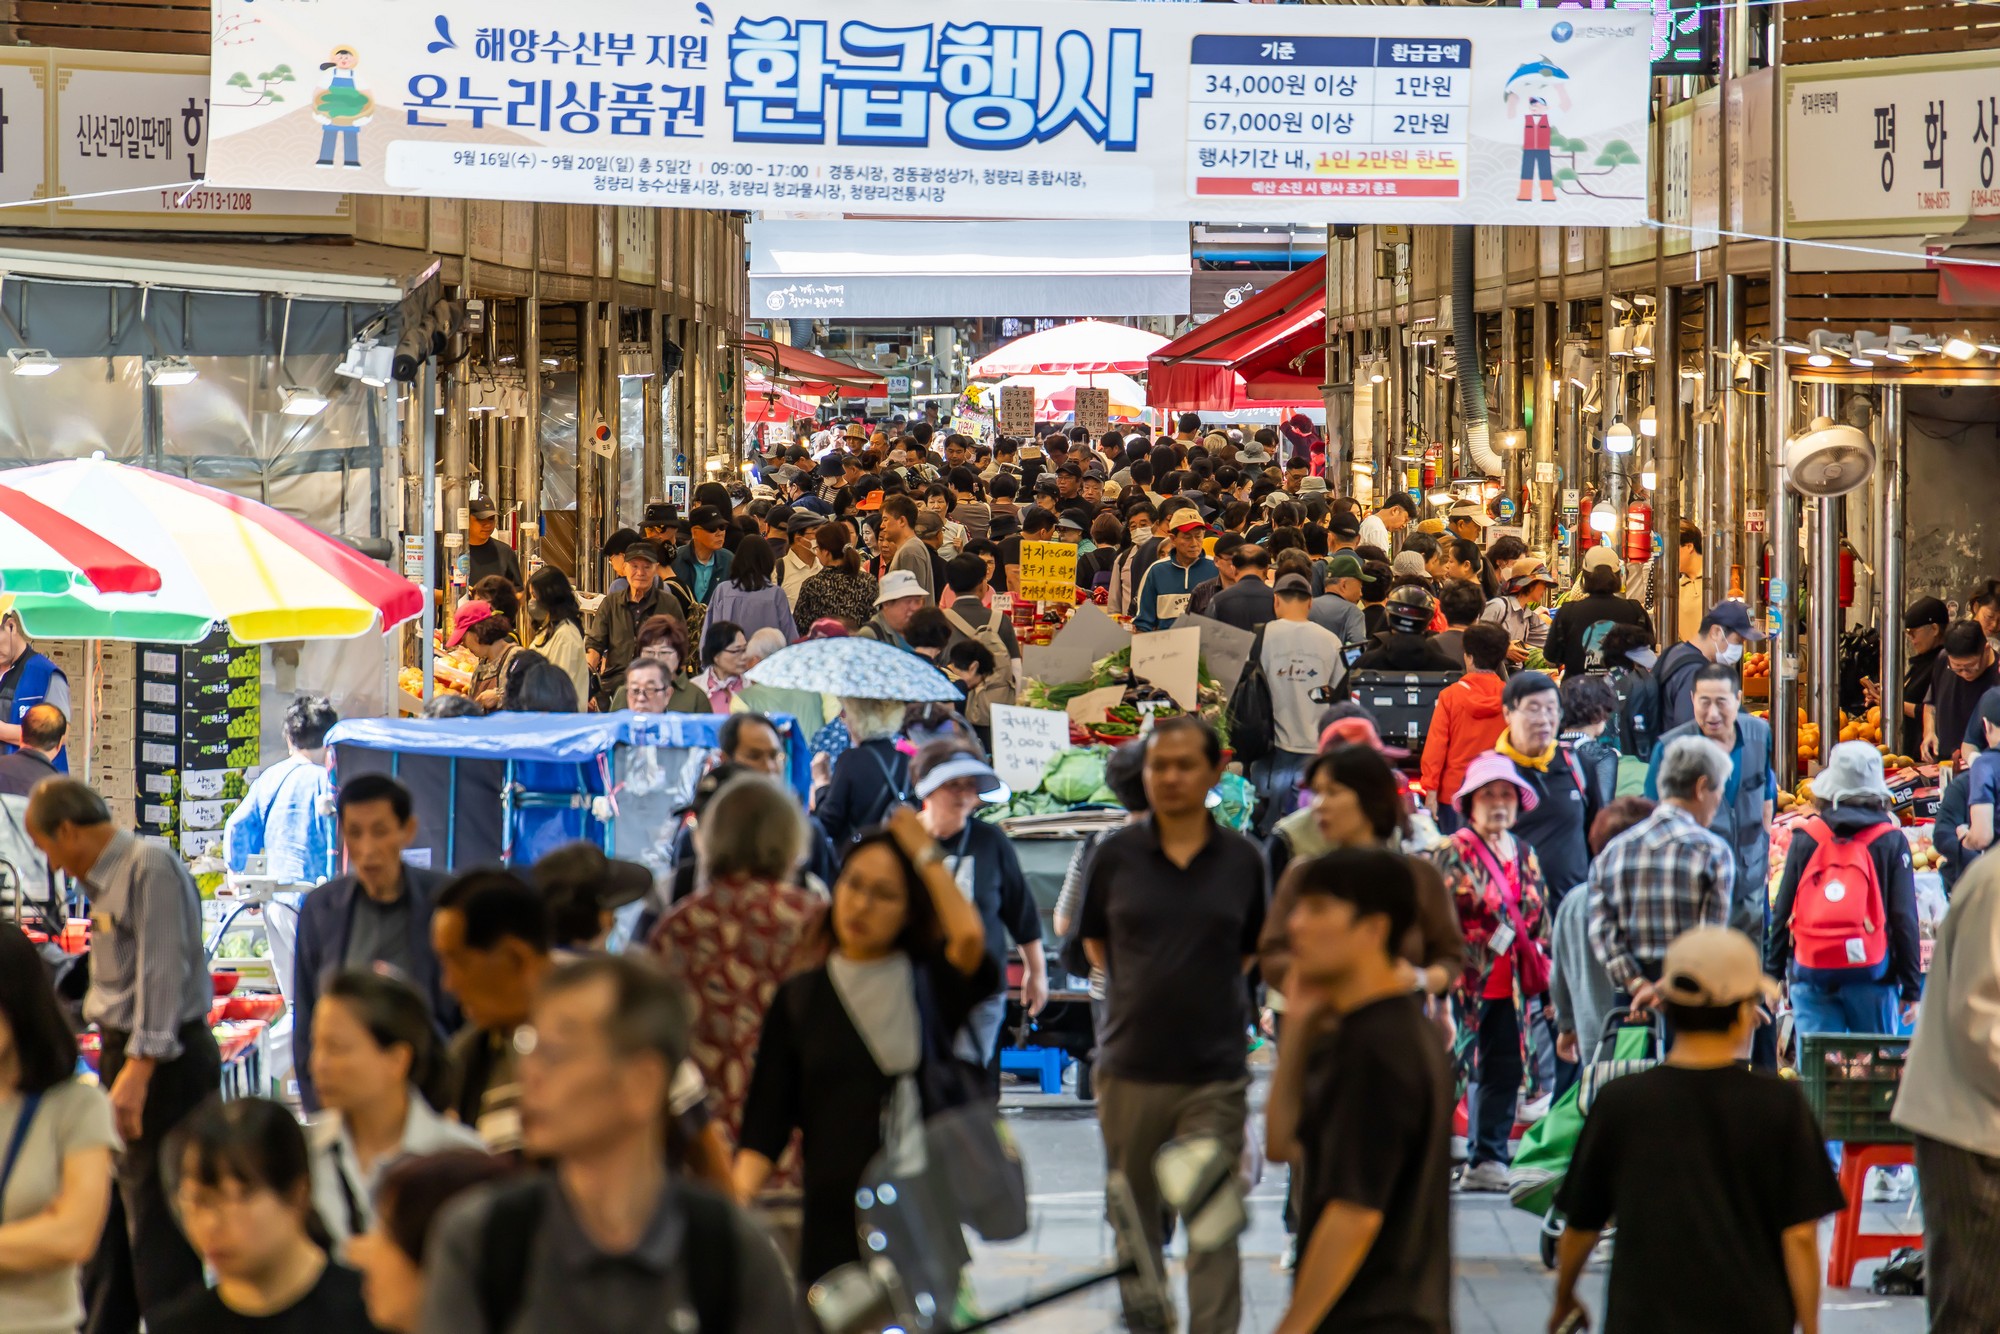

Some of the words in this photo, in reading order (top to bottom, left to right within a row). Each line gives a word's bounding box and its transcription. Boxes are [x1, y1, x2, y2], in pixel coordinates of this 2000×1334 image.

[474, 28, 636, 66] 해양수산부
[646, 34, 710, 70] 지원
[1261, 41, 1297, 60] 기준
[1391, 43, 1461, 64] 환급금액
[725, 15, 1154, 152] 환급행사
[1205, 74, 1306, 97] 34,000원
[1315, 75, 1358, 97] 이상
[1394, 75, 1452, 98] 1만원
[403, 73, 707, 138] 온누리상품권
[1203, 112, 1304, 135] 67,000원
[1310, 112, 1354, 135] 이상
[1393, 113, 1450, 135] 2만원
[77, 114, 173, 161] 신선과일판매
[453, 151, 476, 166] 9월
[479, 151, 537, 170] 16일(수)
[551, 153, 574, 169] 9월
[577, 154, 635, 173] 20일(일)
[638, 157, 653, 173] 총
[655, 158, 692, 175] 5일간
[711, 162, 753, 176] 09:00
[768, 163, 809, 178] 17:00
[829, 164, 889, 183] 경동시장,
[892, 165, 979, 185] 경동광성상가,
[983, 166, 1024, 186] 청량리
[1028, 167, 1088, 188] 종합시장,
[1198, 147, 1281, 169] 행사기간
[1285, 148, 1311, 171] 내,
[1318, 152, 1351, 170] 1인
[1357, 151, 1410, 170] 2만원
[1416, 150, 1456, 170] 한도
[593, 174, 634, 192] 청량리
[637, 176, 724, 197] 농수산물시장,
[728, 181, 770, 198] 청량리
[773, 182, 847, 200] 청과물시장,
[850, 183, 946, 202] 청량리전통시장
[1251, 181, 1276, 194] 예산
[1278, 181, 1303, 194] 소진
[1305, 182, 1318, 194] 시
[1320, 182, 1344, 194] 행사
[1346, 182, 1371, 194] 조기
[1372, 182, 1397, 194] 종료
